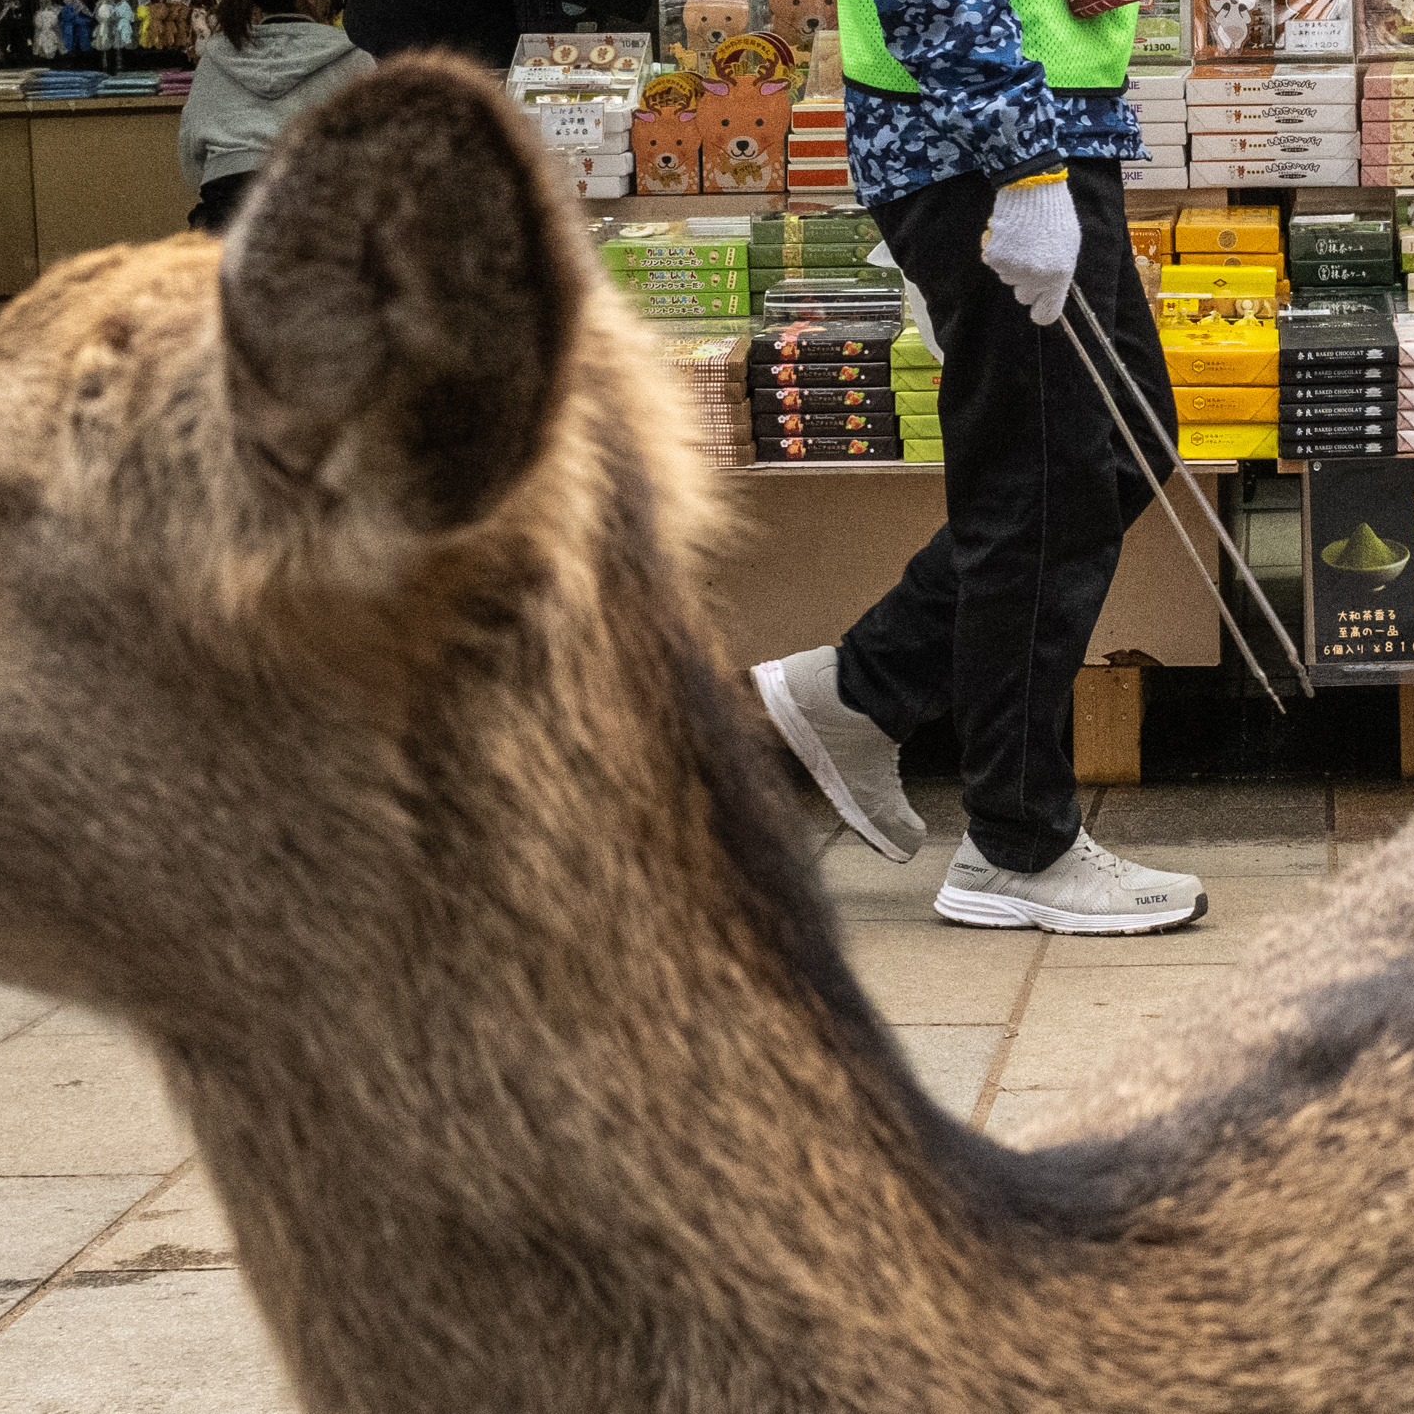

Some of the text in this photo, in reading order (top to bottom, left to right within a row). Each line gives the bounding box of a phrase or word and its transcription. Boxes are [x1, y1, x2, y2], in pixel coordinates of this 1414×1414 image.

[1143, 43, 1170, 51] ¥1300
[1337, 610, 1397, 622] 大和茶香る
[1337, 625, 1399, 638] 至高の一品
[1323, 644, 1366, 657] 6個入り
[953, 862, 988, 874] COMFORT
[1135, 894, 1168, 905] TULTEX
